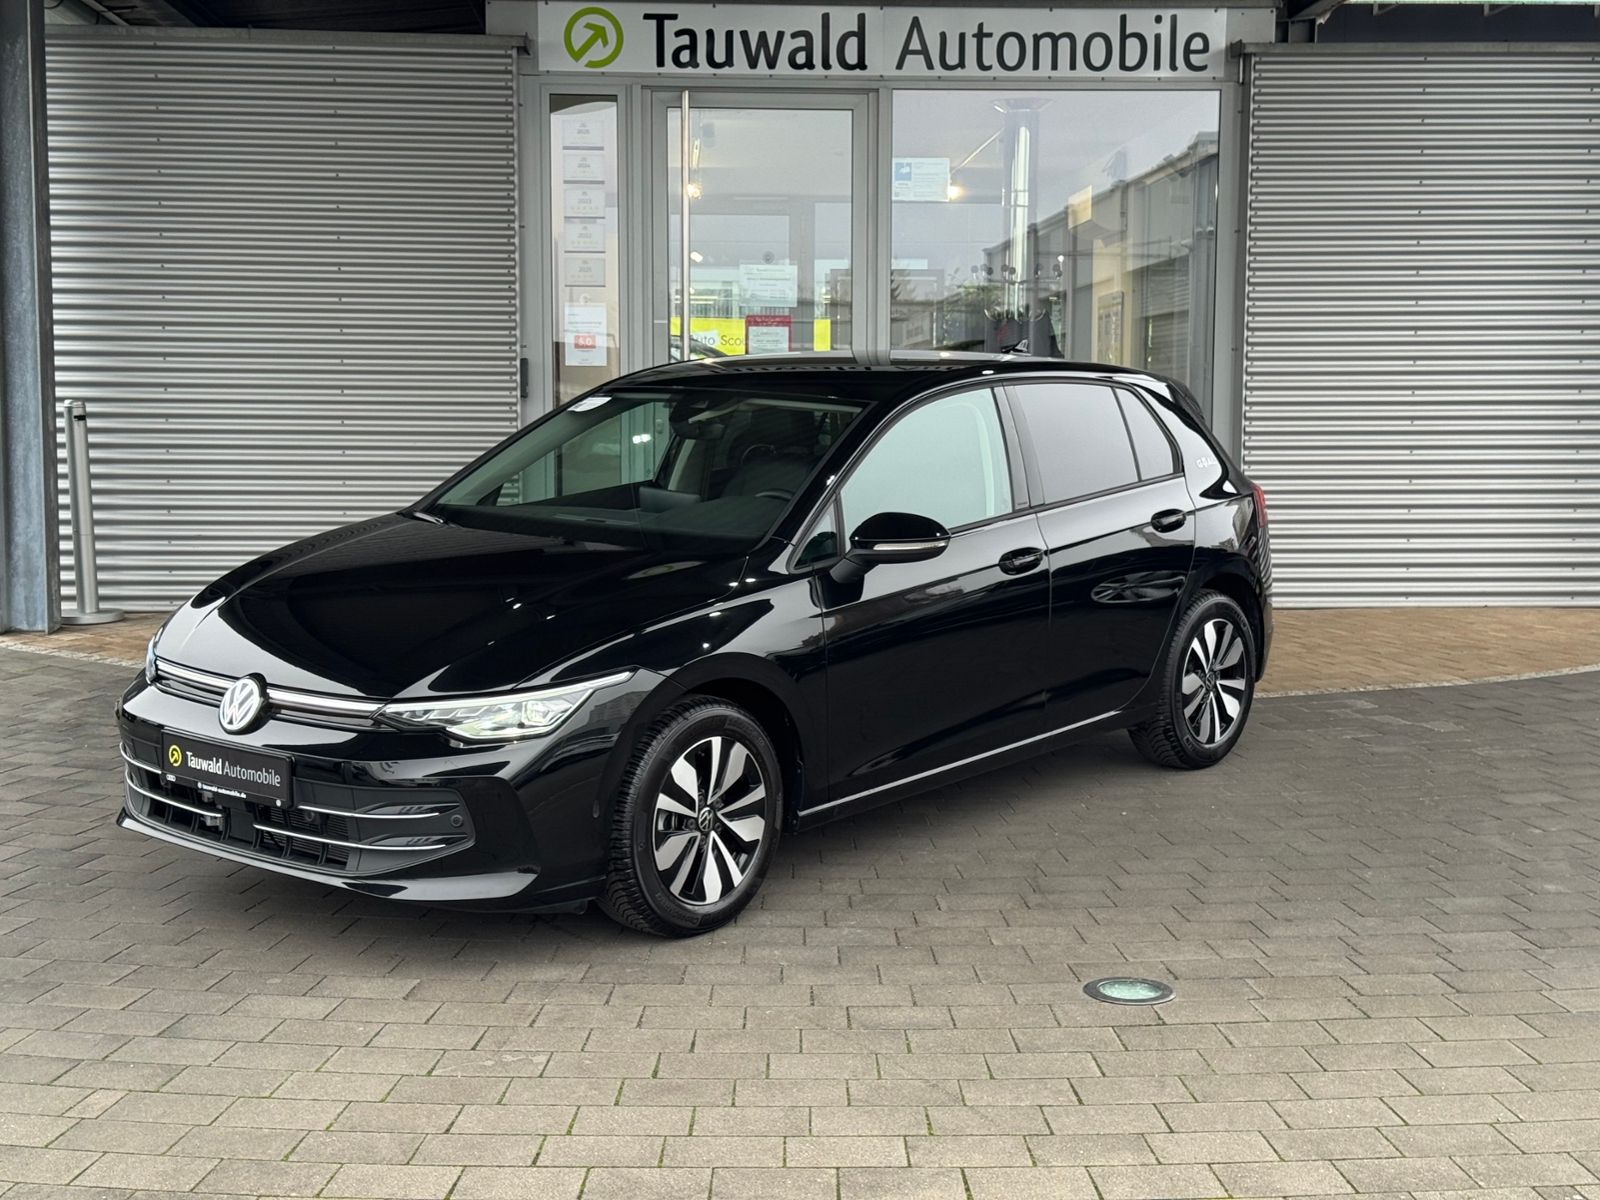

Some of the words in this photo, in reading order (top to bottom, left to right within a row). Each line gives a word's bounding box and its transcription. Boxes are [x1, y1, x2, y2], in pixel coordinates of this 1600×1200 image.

[643, 12, 868, 71] Tauwald
[895, 14, 1210, 72] Automobile
[185, 751, 222, 775] Tauwald
[223, 761, 281, 787] Automobile
